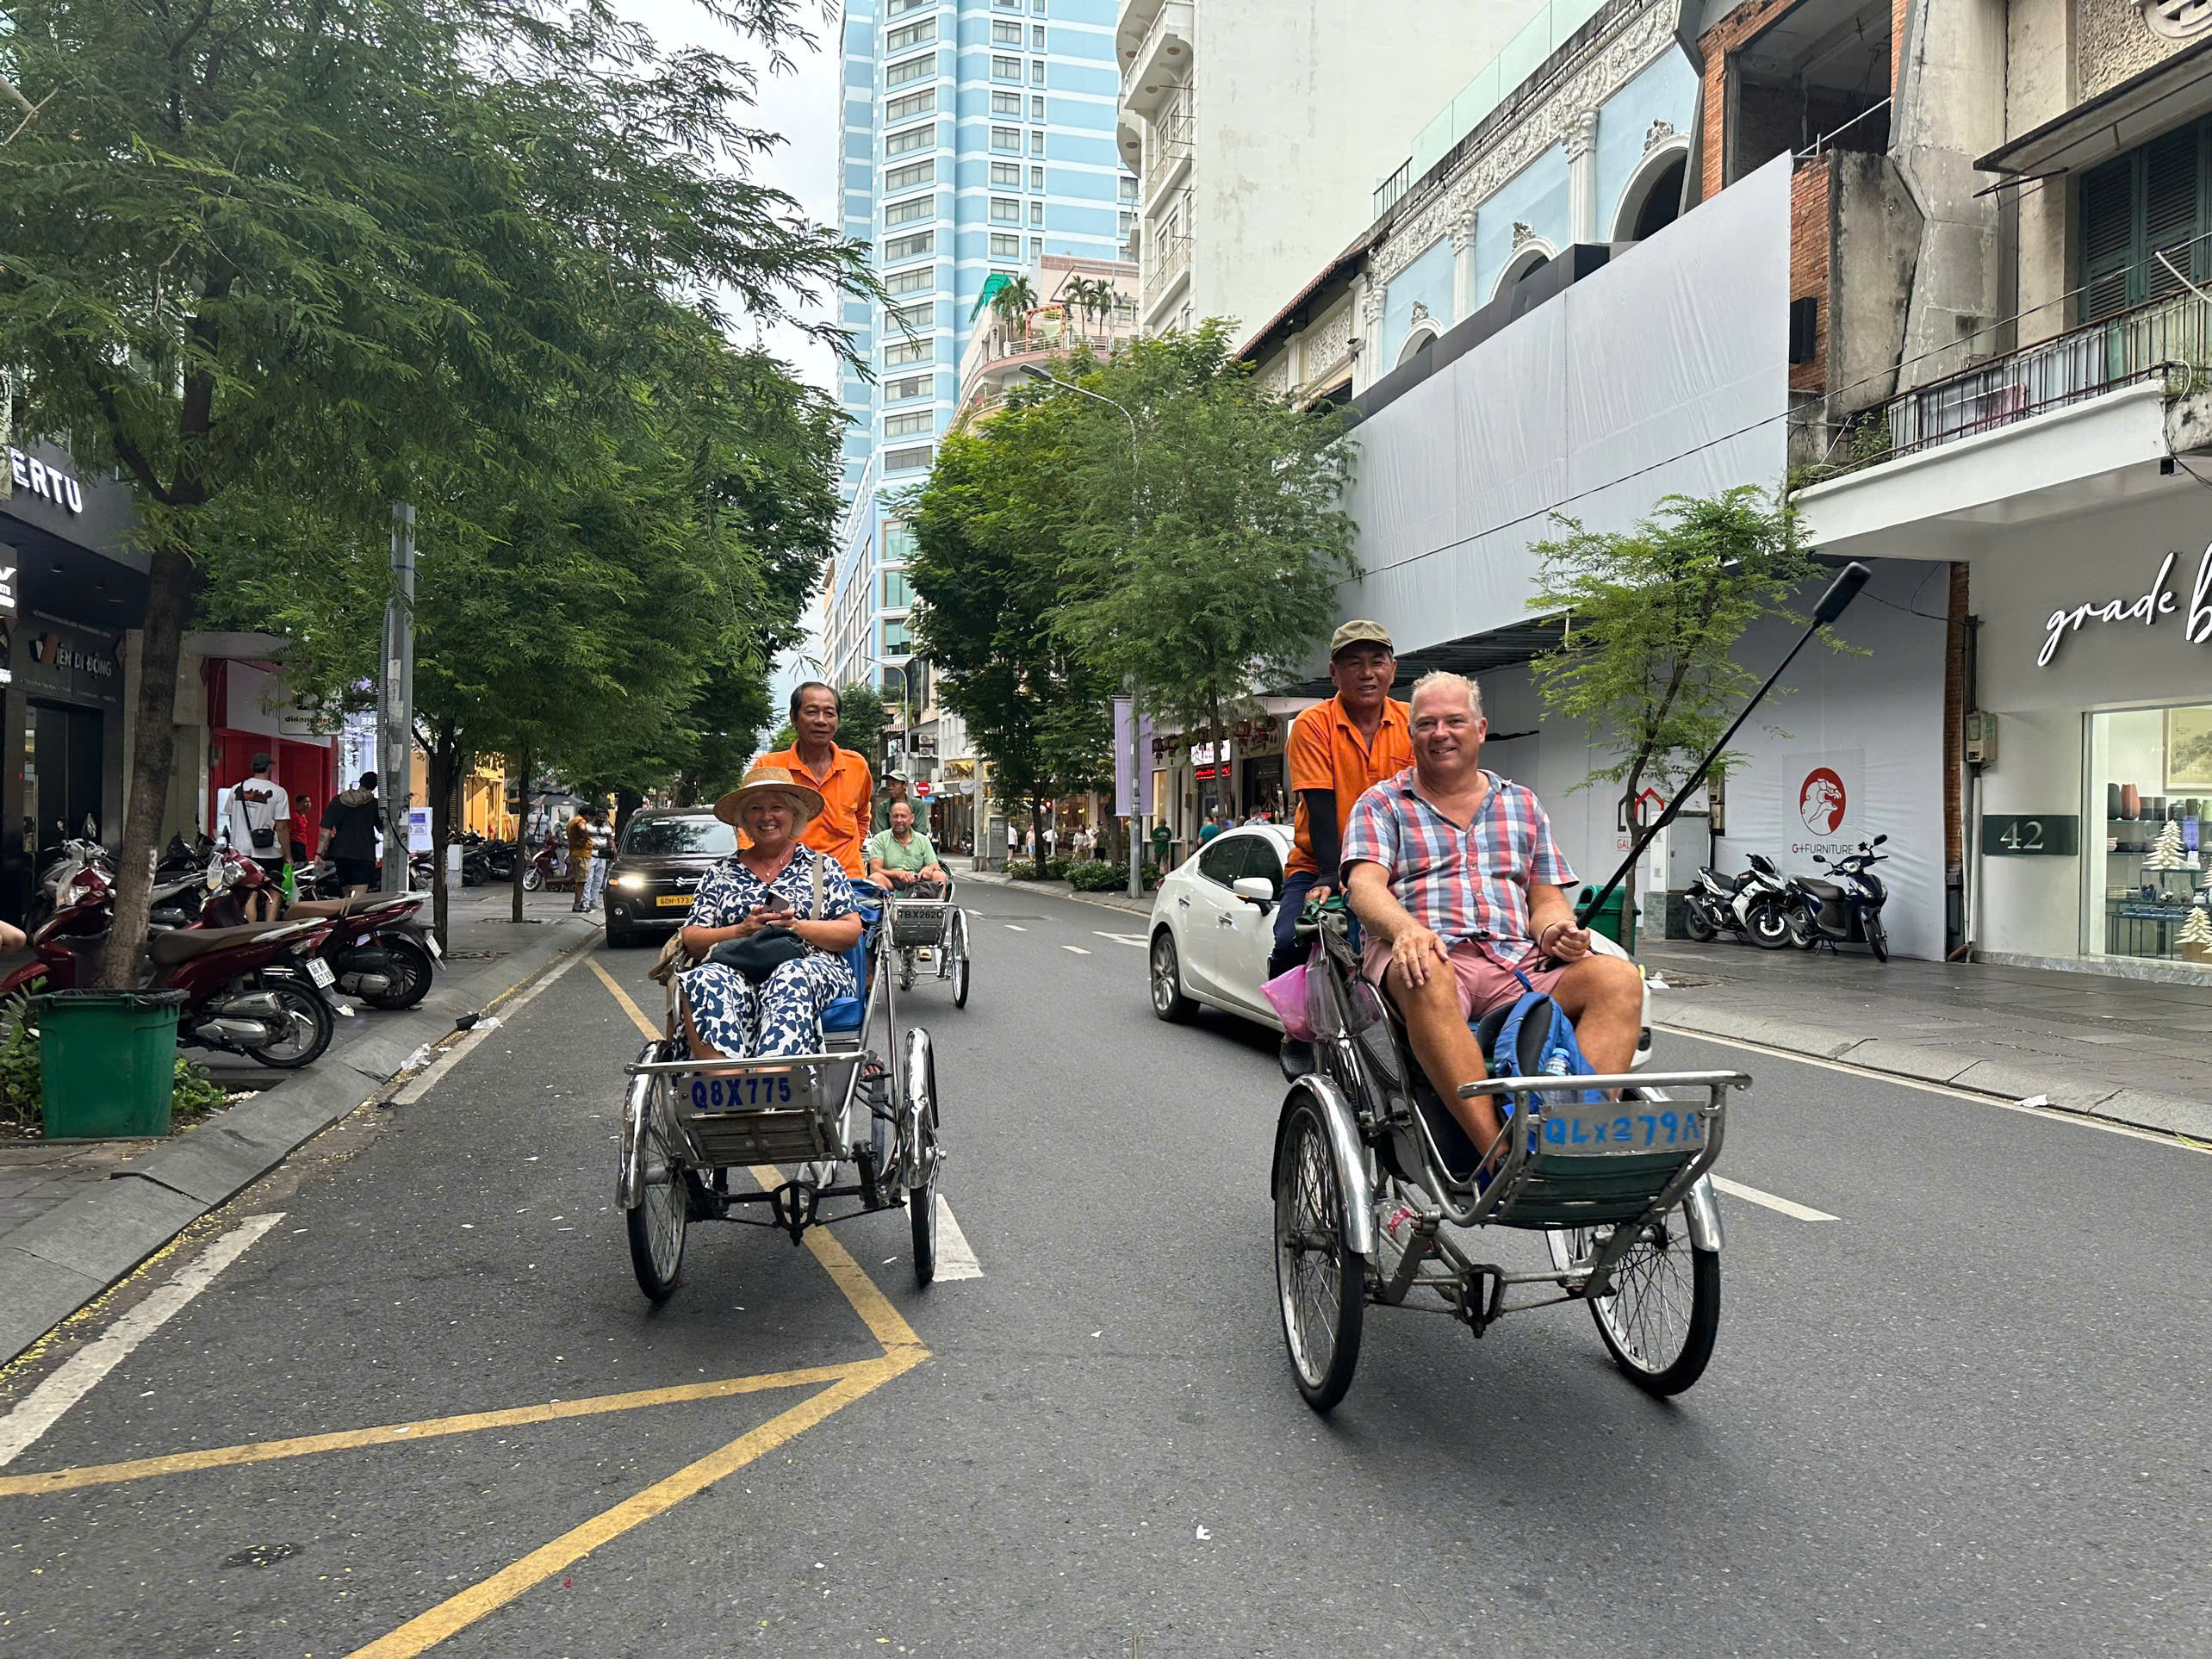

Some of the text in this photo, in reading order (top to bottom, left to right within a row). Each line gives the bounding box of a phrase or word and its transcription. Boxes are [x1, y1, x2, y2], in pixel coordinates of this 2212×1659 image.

[10, 447, 83, 513] ERTU
[2038, 551, 2177, 667] grade
[1792, 843, 1854, 854] G+FURNITURE
[2000, 821, 2044, 849] 42
[692, 1077, 791, 1109] Q8X775
